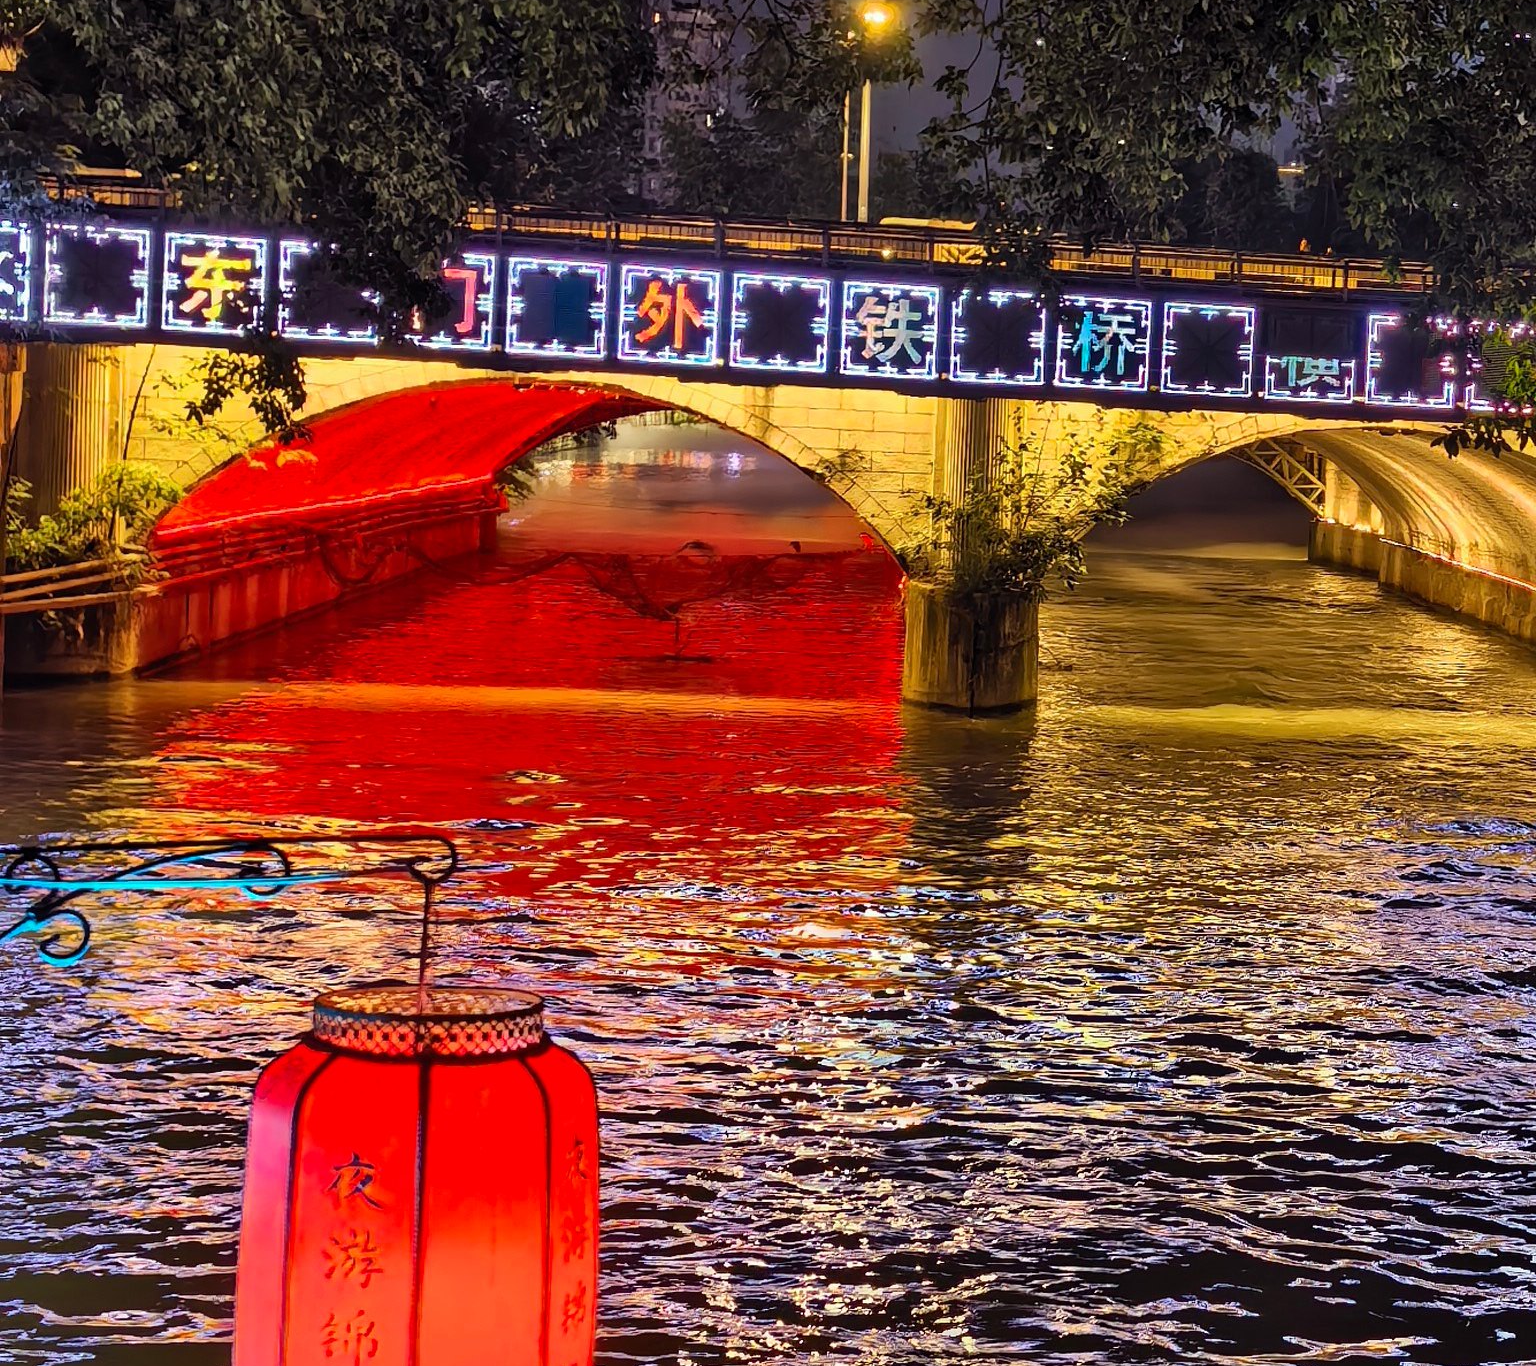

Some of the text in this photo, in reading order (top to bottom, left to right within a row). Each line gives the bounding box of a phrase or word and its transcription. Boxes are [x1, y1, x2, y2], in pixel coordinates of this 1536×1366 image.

[180, 249, 247, 321] 东
[636, 280, 702, 348] 外
[856, 296, 923, 365] 铁
[1073, 310, 1135, 375] 桥
